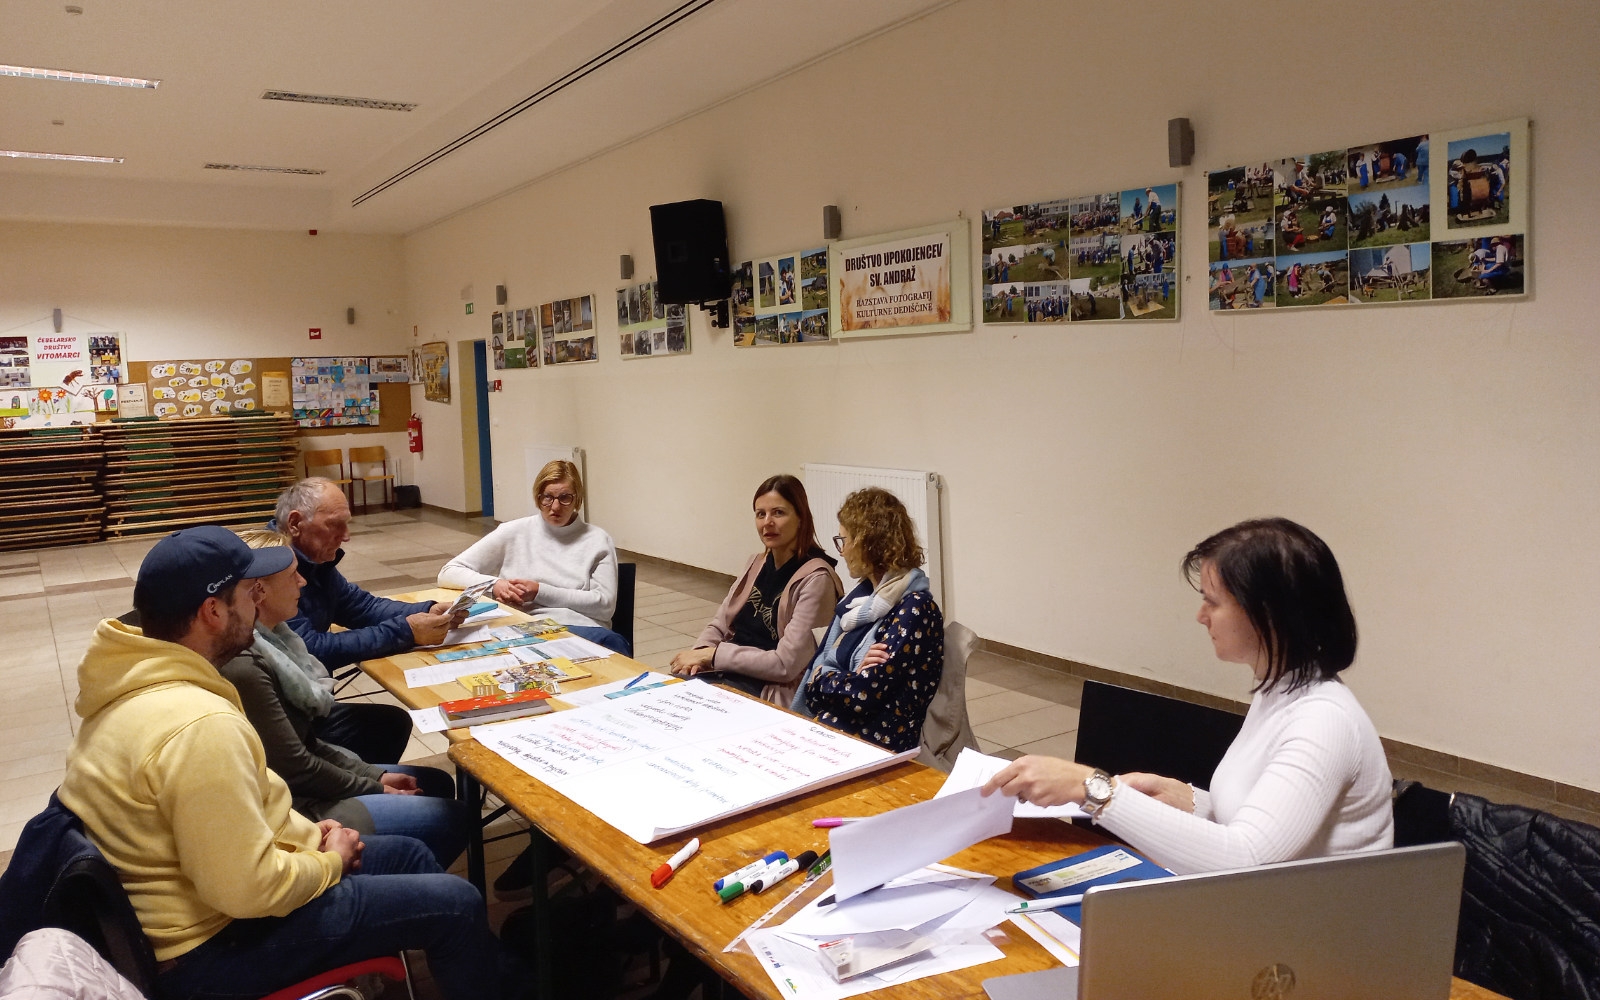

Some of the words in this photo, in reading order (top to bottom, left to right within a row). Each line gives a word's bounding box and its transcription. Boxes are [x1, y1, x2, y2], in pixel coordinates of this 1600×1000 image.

[845, 253, 882, 272] DRUŠTVO
[884, 243, 943, 265] UPOKOJENCEV
[869, 273, 883, 287] SV.
[883, 265, 916, 286] ANDRAŽ
[856, 296, 889, 308] RAZSTAVA
[856, 307, 893, 319] KULTURNE
[893, 302, 933, 315] DEDIŠČINE
